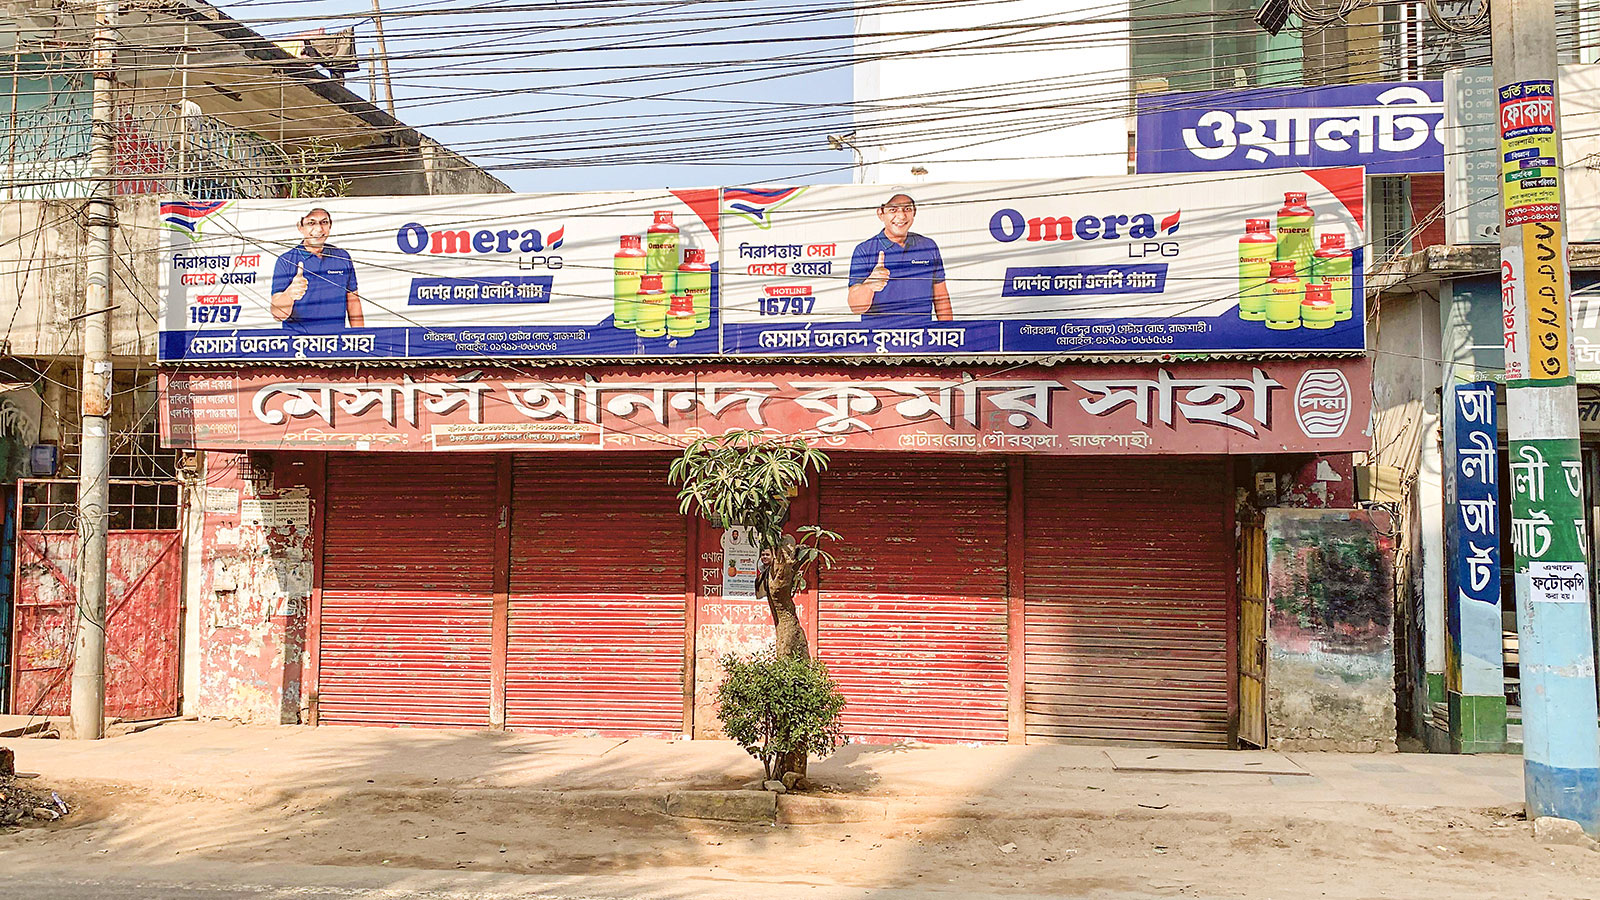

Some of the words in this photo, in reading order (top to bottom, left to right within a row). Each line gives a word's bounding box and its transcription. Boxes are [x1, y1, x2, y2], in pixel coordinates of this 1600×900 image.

[1501, 84, 1522, 99] ভর্তি
[1524, 85, 1552, 95] চলছে
[1502, 98, 1553, 129] ফোকাস
[989, 208, 1157, 243] Omera
[1278, 226, 1304, 234] Omera
[397, 222, 543, 254] Omera
[739, 243, 802, 260] নিরাপত্তায়
[806, 243, 837, 257] সেরা
[1128, 243, 1180, 258] LPG
[173, 253, 231, 270] নিরাপত্তায়
[234, 254, 260, 268] সেরা
[519, 256, 563, 271] LPG
[747, 263, 787, 276] দেশের
[791, 261, 832, 276] ওমেরা
[180, 273, 217, 286] দেশের
[220, 271, 257, 285] ওমেরা
[1013, 274, 1051, 291] দেশের
[1054, 273, 1083, 289] সেরা
[1085, 269, 1123, 289] এলপি
[1126, 271, 1157, 288] গ্যাস
[417, 284, 451, 301] দেশের
[453, 284, 479, 300] সেরা
[481, 280, 515, 299] এলপি
[516, 284, 544, 298] গ্যাস
[772, 287, 808, 296] HOTLINE
[203, 296, 235, 304] HOTLINE
[758, 297, 815, 316] 16797
[190, 306, 241, 324] 16797
[459, 330, 486, 343] (বিন্দুর
[532, 332, 552, 341] রোড,
[553, 329, 586, 340] রাজশাহী
[758, 322, 812, 348] মেসার্স
[872, 327, 925, 354] কুমার
[927, 327, 966, 347] সাহা
[1019, 325, 1059, 336] গৌরহাঙ্গা,
[1060, 324, 1090, 338] (বিন্দুর
[1091, 324, 1116, 335] মোড়)
[1144, 324, 1167, 333] রোড,
[1168, 321, 1207, 333] রাজশাহী
[191, 330, 237, 354] মেসার্স
[291, 334, 339, 359] কুমার
[341, 334, 375, 352] সাহা
[1056, 336, 1094, 345] মোবাইল:
[1095, 335, 1174, 345] ০১৭১১-৩৬৬৫৬৪
[251, 373, 497, 429] মেসার্স
[502, 371, 783, 427] আনন্দ
[786, 371, 1060, 435] কুমার
[1071, 367, 1287, 439] সাহা
[1300, 397, 1345, 409] পদ্মা
[1531, 573, 1585, 591] ফটোকপি
